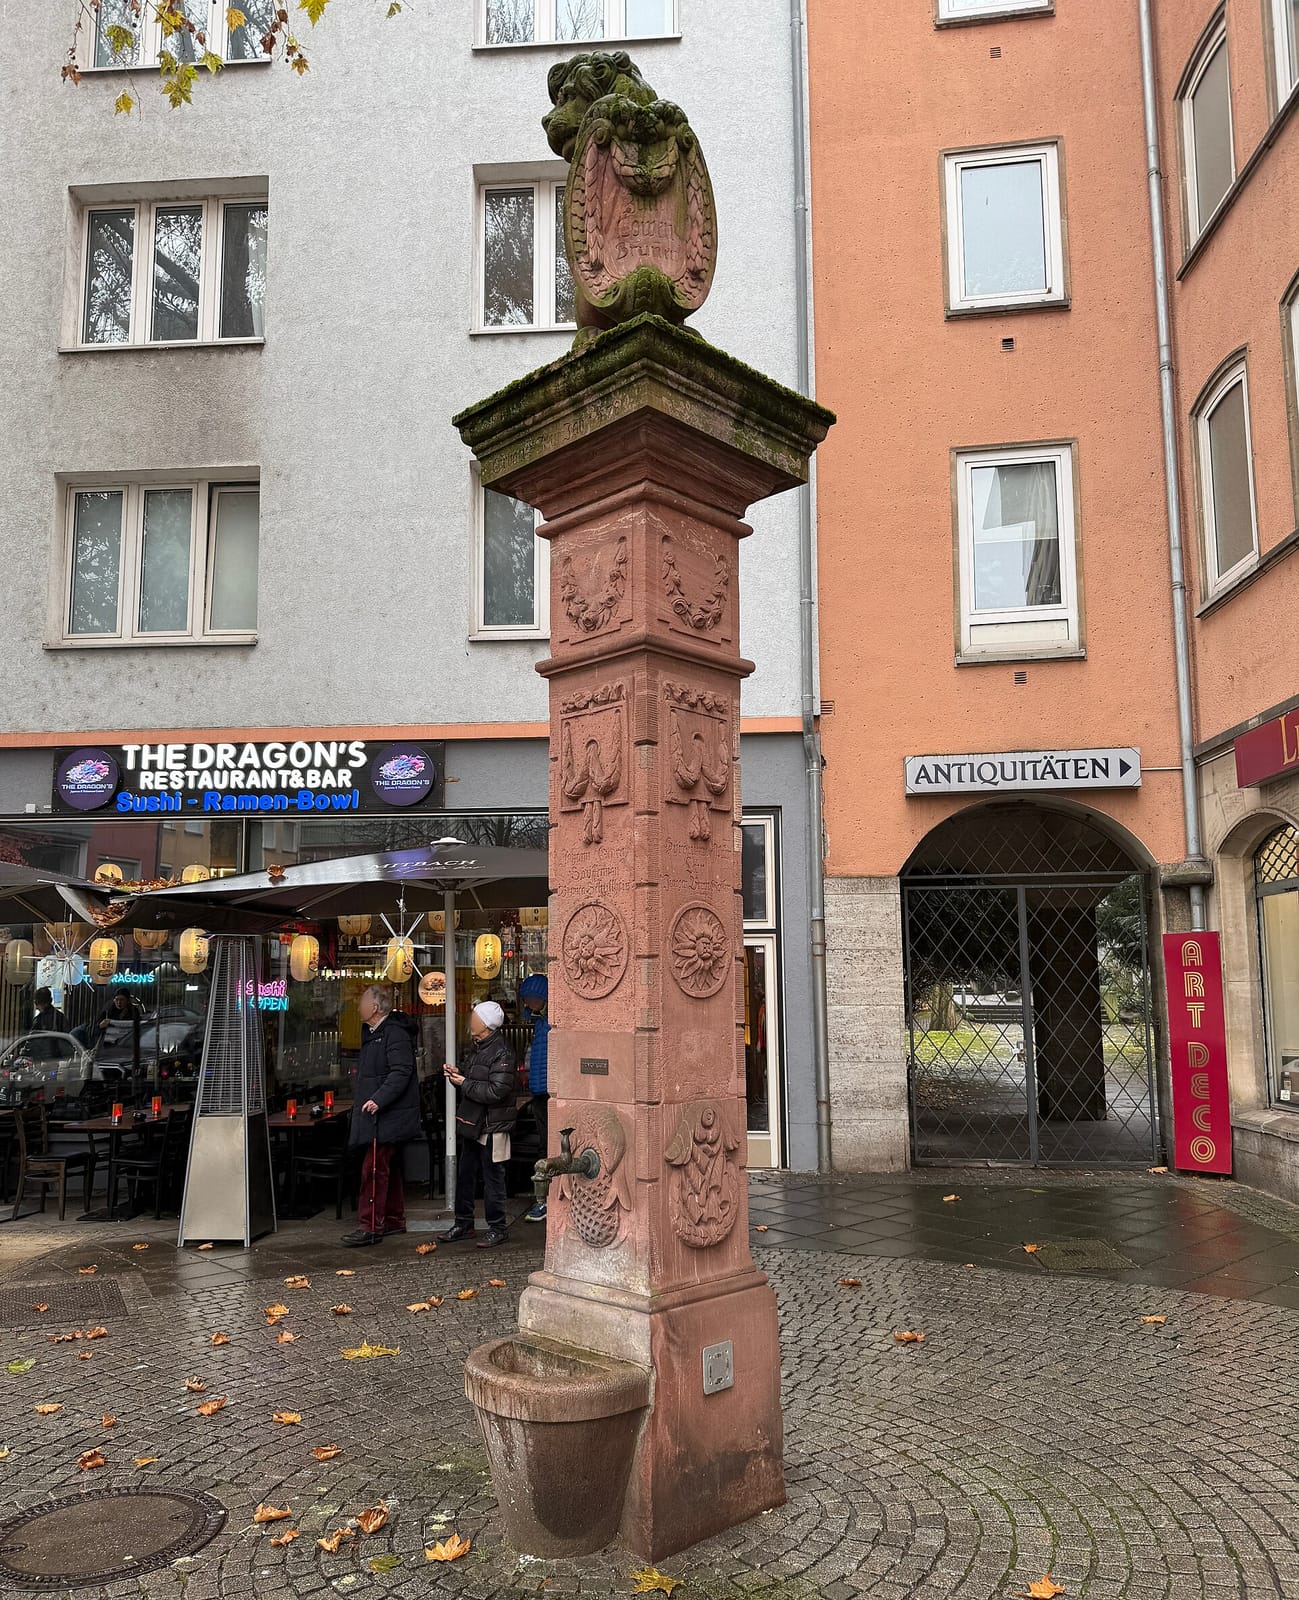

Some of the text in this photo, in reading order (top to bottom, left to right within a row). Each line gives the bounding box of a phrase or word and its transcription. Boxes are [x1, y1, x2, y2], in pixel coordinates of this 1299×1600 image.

[121, 741, 368, 771] THE DRAGON'S
[914, 755, 1110, 786] ANTIQUITÄTEN
[139, 769, 353, 791] RESTAURANT&BAR
[116, 790, 183, 812] Sushi
[203, 788, 360, 812] Ramen-Bowl
[111, 973, 156, 983] RAGON'S
[1181, 940, 1206, 1029] ART
[1187, 1041, 1217, 1164] DECO
